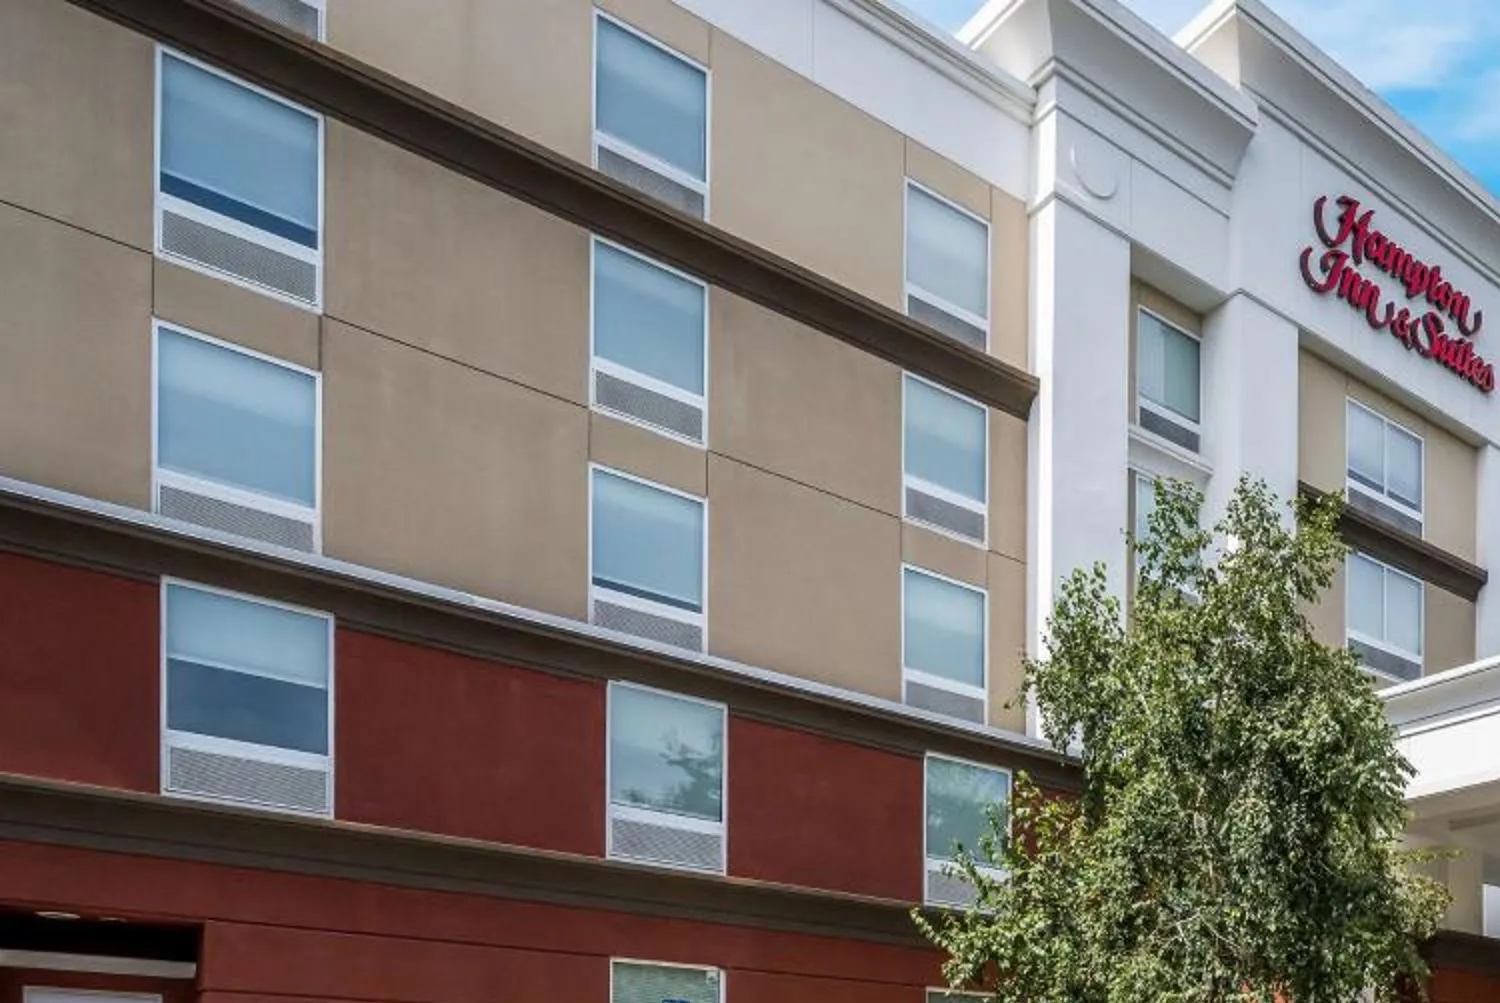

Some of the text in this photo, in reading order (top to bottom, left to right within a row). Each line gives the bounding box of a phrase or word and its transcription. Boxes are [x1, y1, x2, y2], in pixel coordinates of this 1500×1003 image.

[1300, 247, 1494, 392] Inn & Suites
[1313, 195, 1482, 336] Hampton
